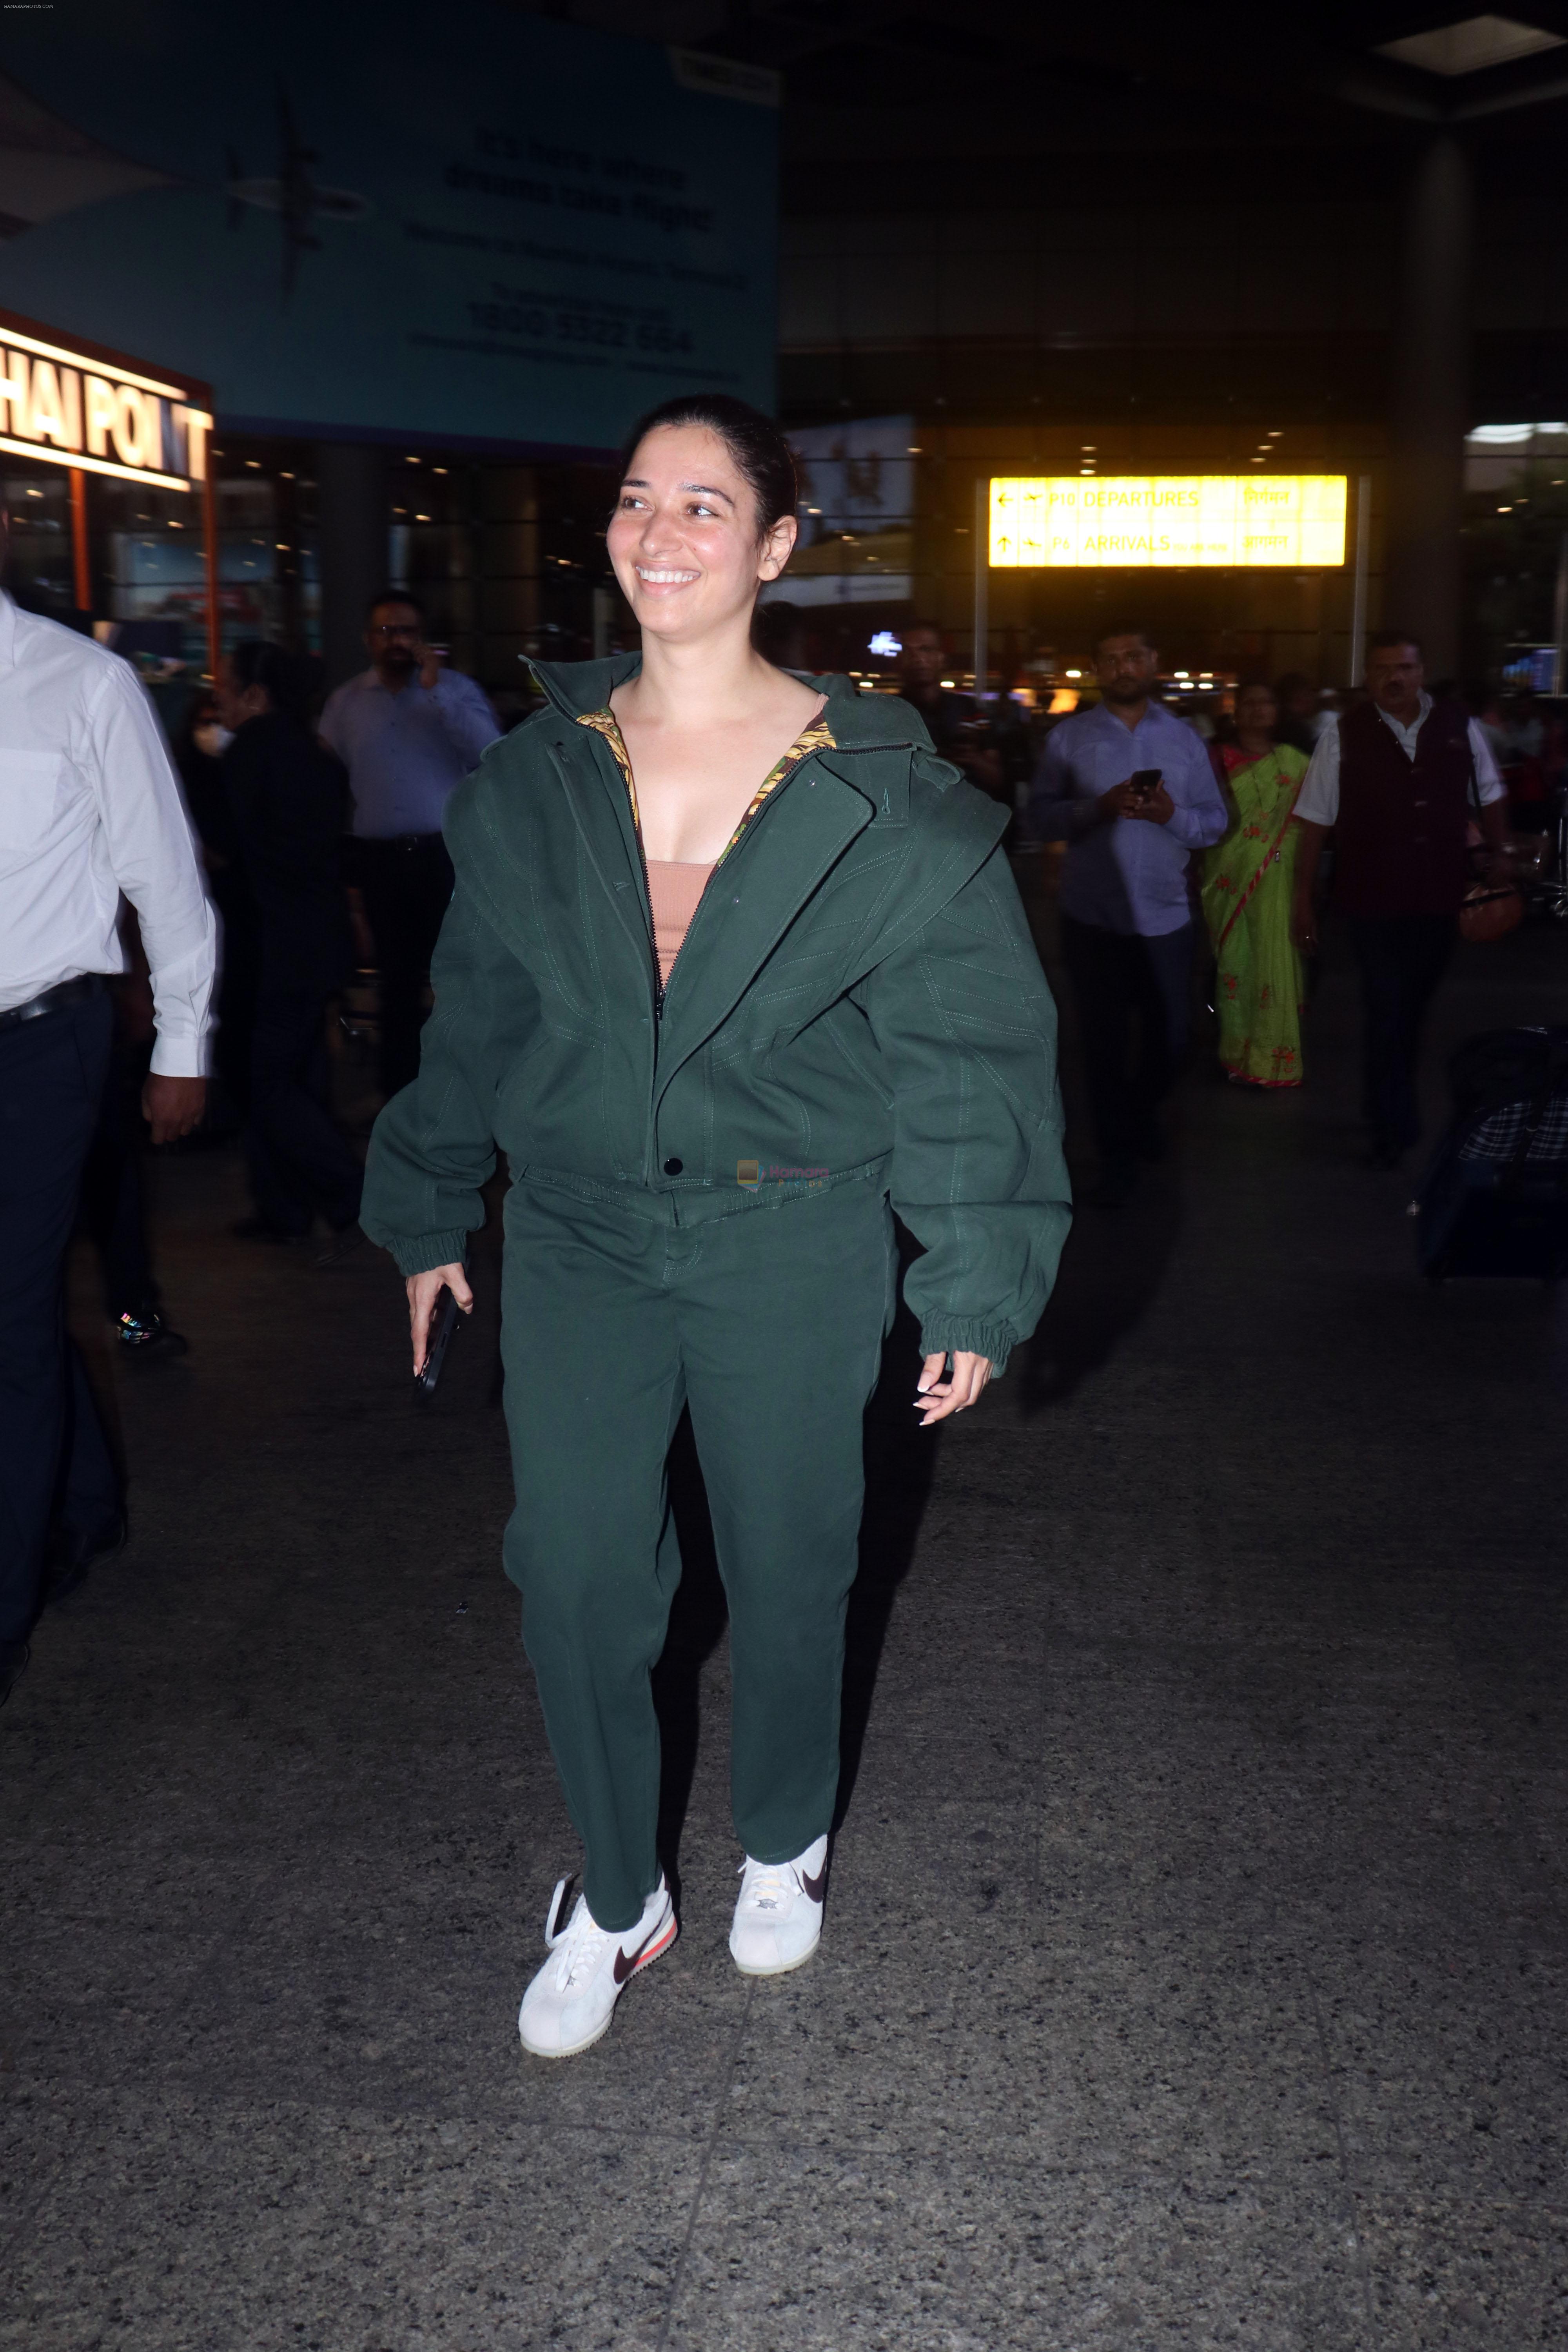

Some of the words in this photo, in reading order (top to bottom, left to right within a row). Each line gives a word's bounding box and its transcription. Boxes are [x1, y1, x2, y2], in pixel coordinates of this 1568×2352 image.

[1049, 492, 1076, 507] P10
[1084, 490, 1199, 508] DEPARTURES
[1243, 486, 1290, 505] निर्गमन
[1053, 535, 1071, 551] P6
[1084, 534, 1171, 552] ARRIVALS
[1242, 535, 1289, 549] आगमन
